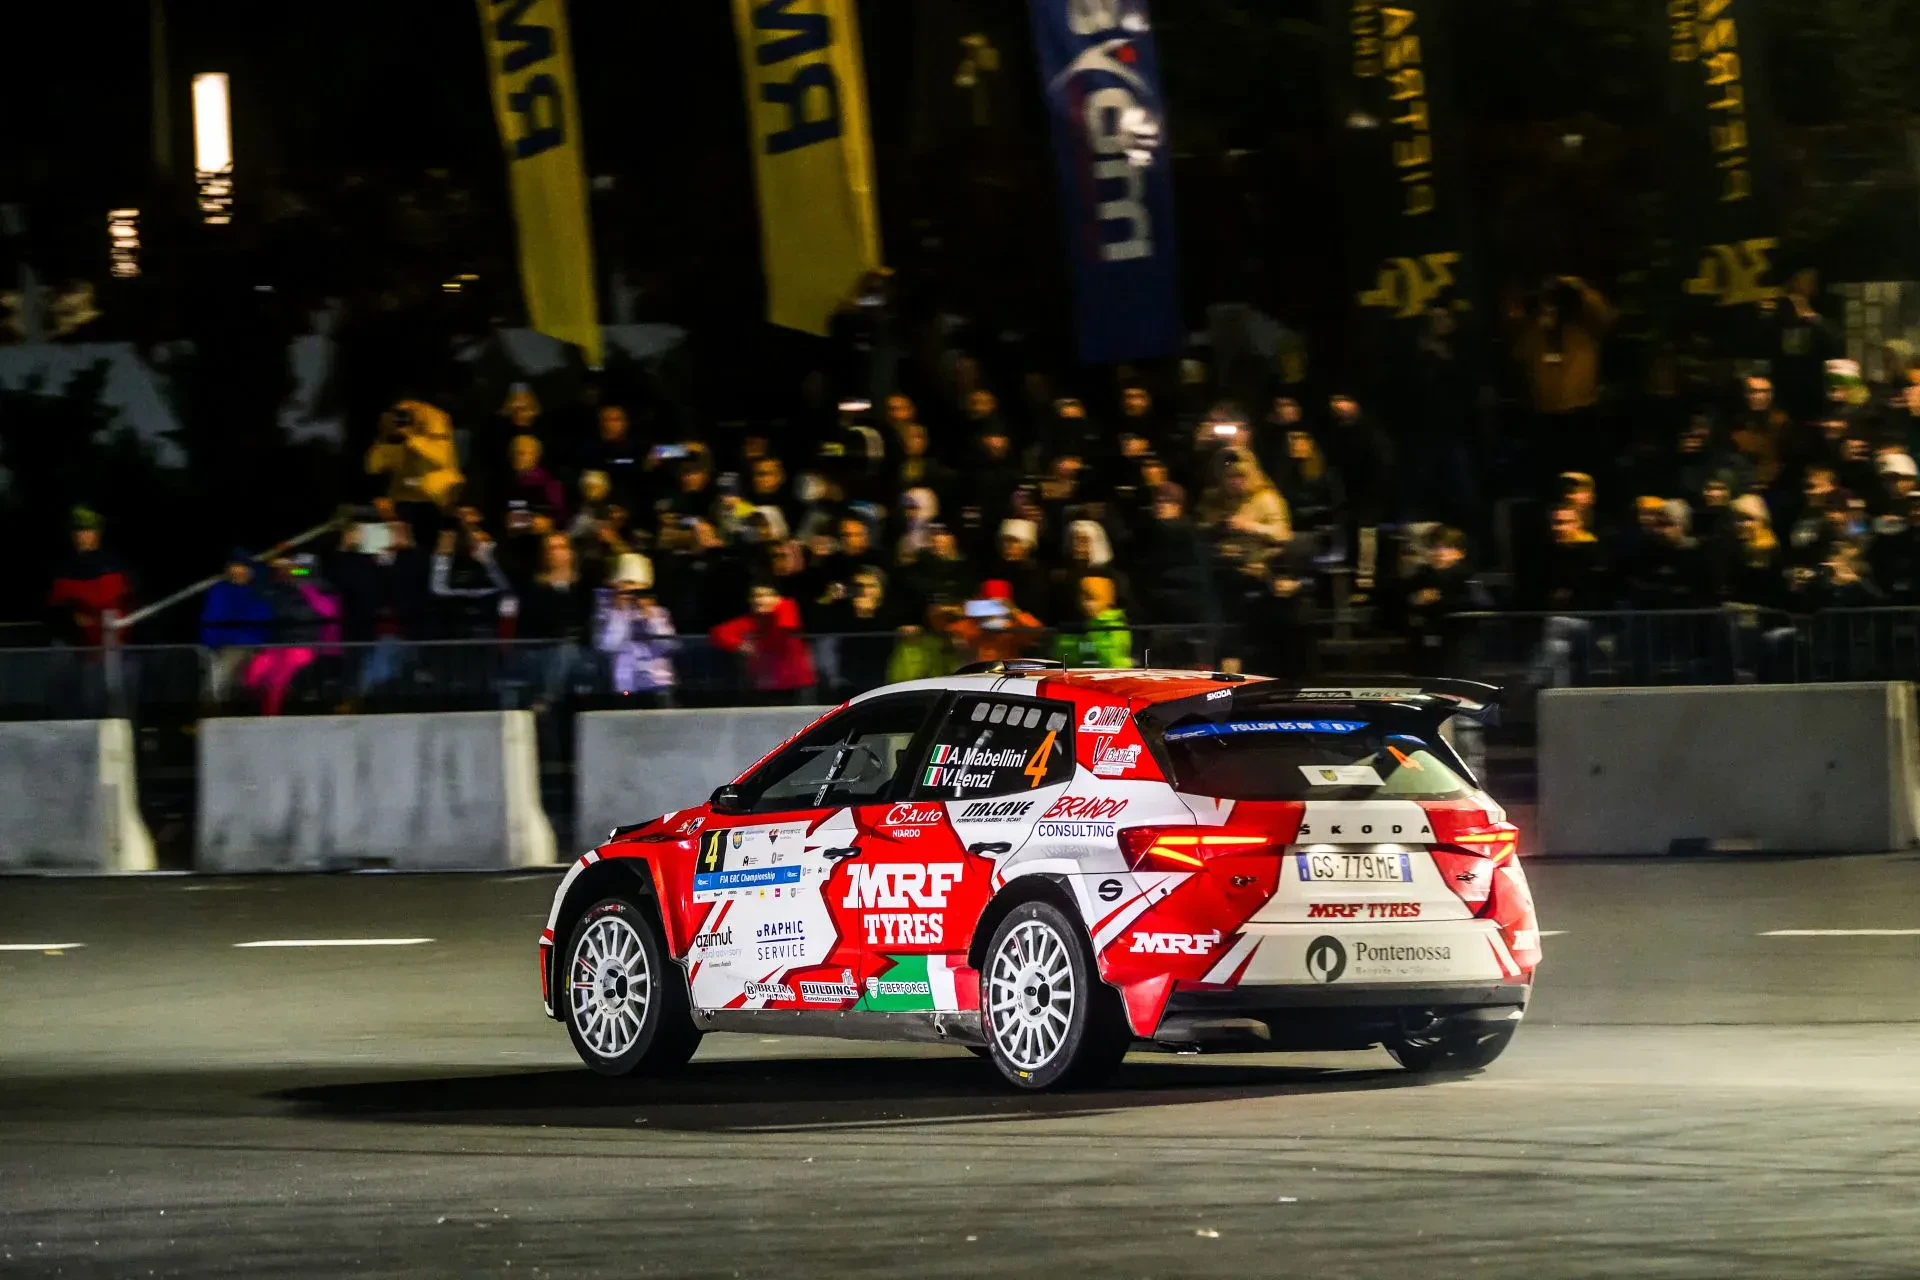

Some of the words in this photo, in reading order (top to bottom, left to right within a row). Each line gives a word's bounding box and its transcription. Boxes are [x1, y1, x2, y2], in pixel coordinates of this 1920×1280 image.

[1230, 723, 1278, 732] FOLLOW
[1281, 722, 1296, 730] US
[947, 747, 1027, 769] A.Mabellini
[1024, 730, 1057, 788] 4
[941, 770, 995, 789] V.Lenzi
[961, 801, 1035, 817] ITALCAVE
[1043, 796, 1129, 820] BRANDO
[892, 829, 920, 838] NIARDO
[1038, 824, 1114, 838] CONSULTING
[705, 831, 721, 871] 4
[720, 875, 729, 884] FIA
[730, 874, 740, 883] ERC
[741, 872, 776, 884] Championship
[842, 863, 964, 908] MRF
[1308, 903, 1363, 918] MRF
[1367, 903, 1421, 917] TYRES
[696, 926, 733, 948] azimut
[864, 914, 944, 945] TYRES
[1130, 931, 1220, 954] MRF
[758, 944, 805, 960] SERVICE
[1356, 942, 1452, 961] Pontenossa
[757, 984, 793, 995] BRERA
[802, 984, 851, 996] BUILDING
[880, 983, 929, 993] FIBERFORCE
